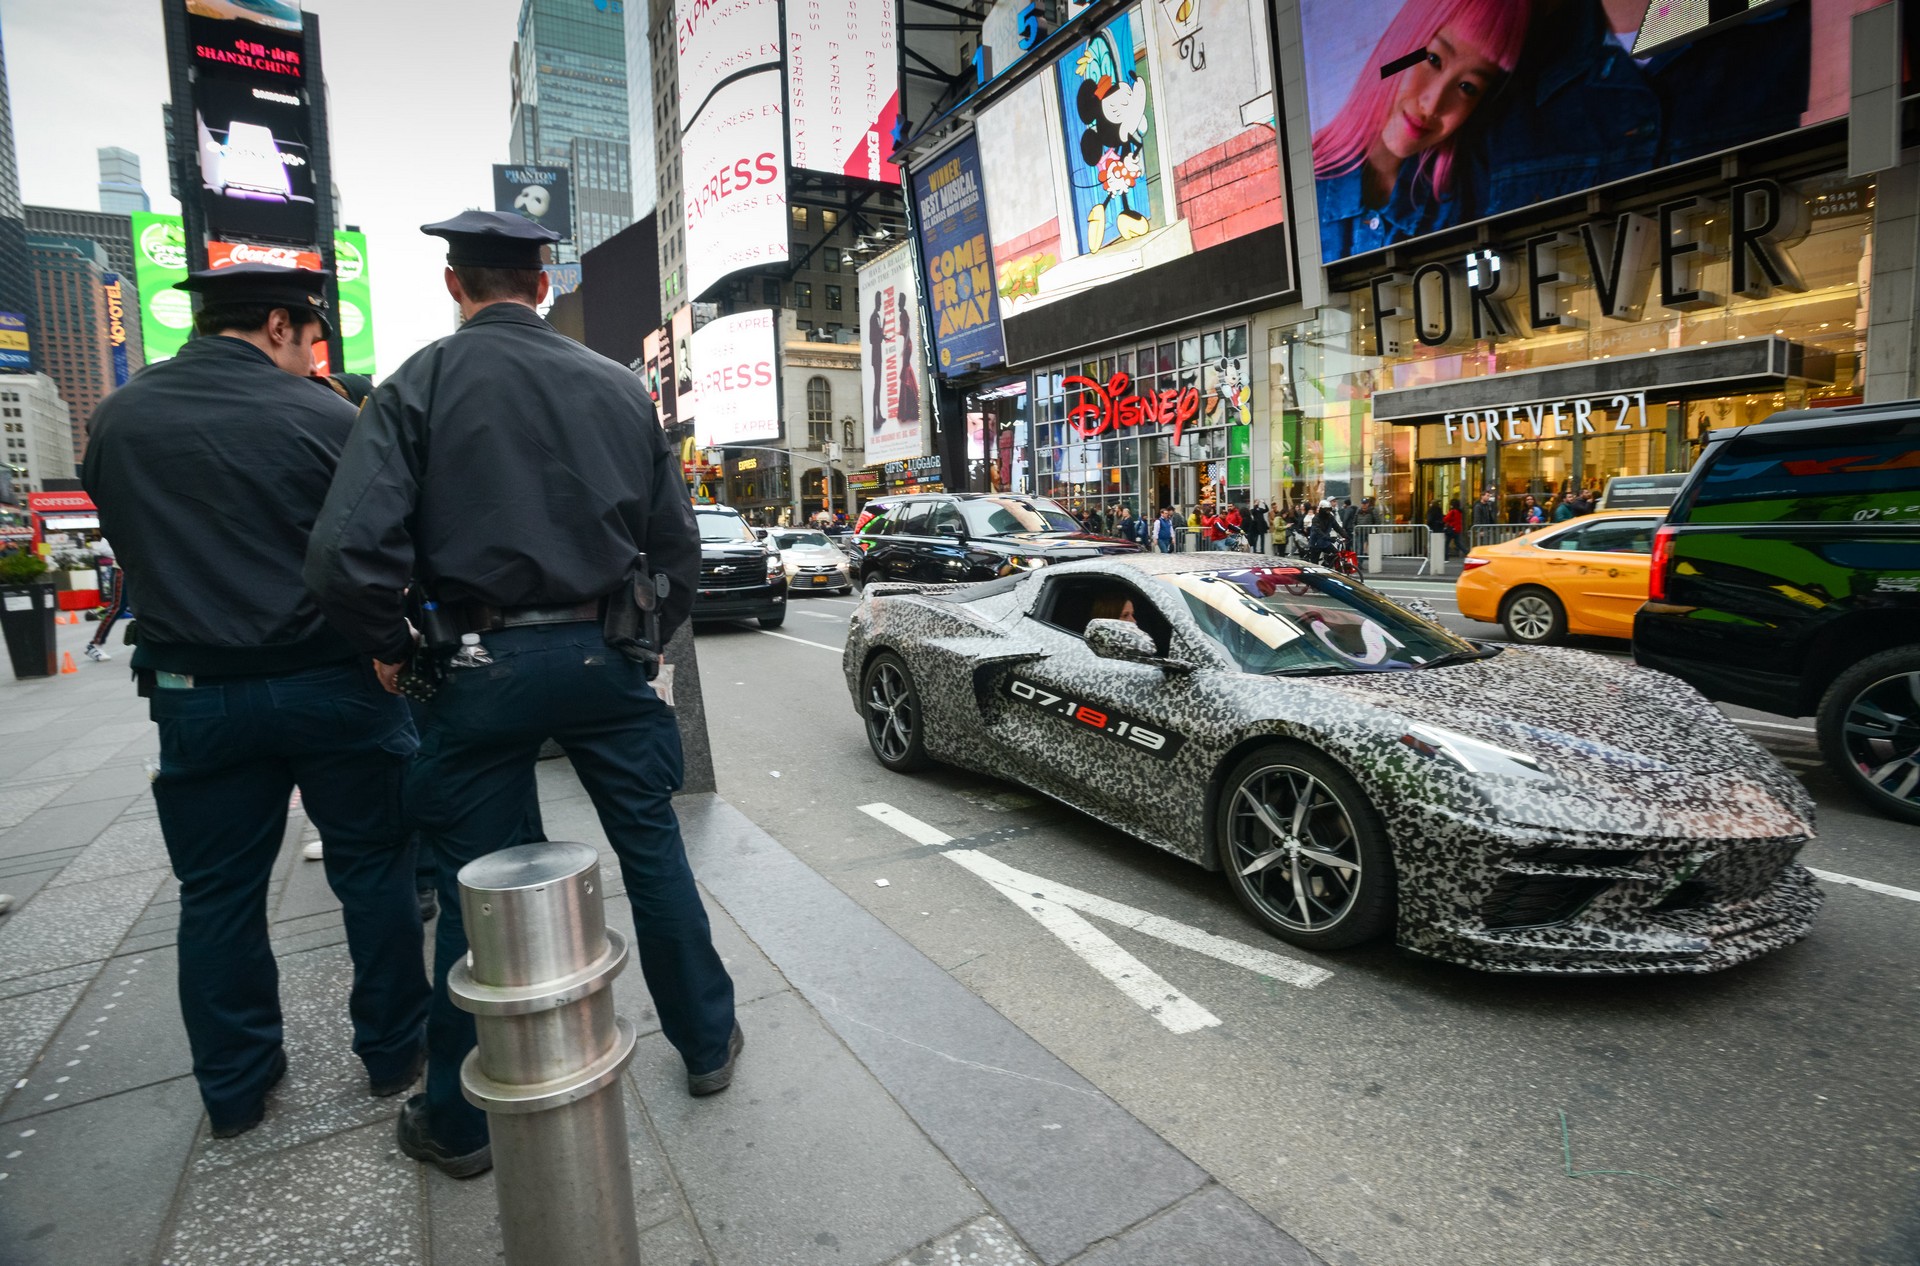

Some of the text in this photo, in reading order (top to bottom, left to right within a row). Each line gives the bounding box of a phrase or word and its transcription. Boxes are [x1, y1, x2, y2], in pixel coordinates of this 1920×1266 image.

[504, 170, 557, 181] PHANTOM
[687, 152, 778, 231] EXPRESS
[920, 169, 978, 220] BEST MUSICAL
[930, 233, 987, 282] COME
[1370, 176, 1785, 358] FOREVER
[938, 291, 992, 338] AWAY
[885, 354, 899, 419] WOMAN
[1444, 392, 1649, 446] FOREVER 21
[884, 455, 941, 474] GIFTS LUGGAGE
[1010, 680, 1166, 751] 07.18.19
